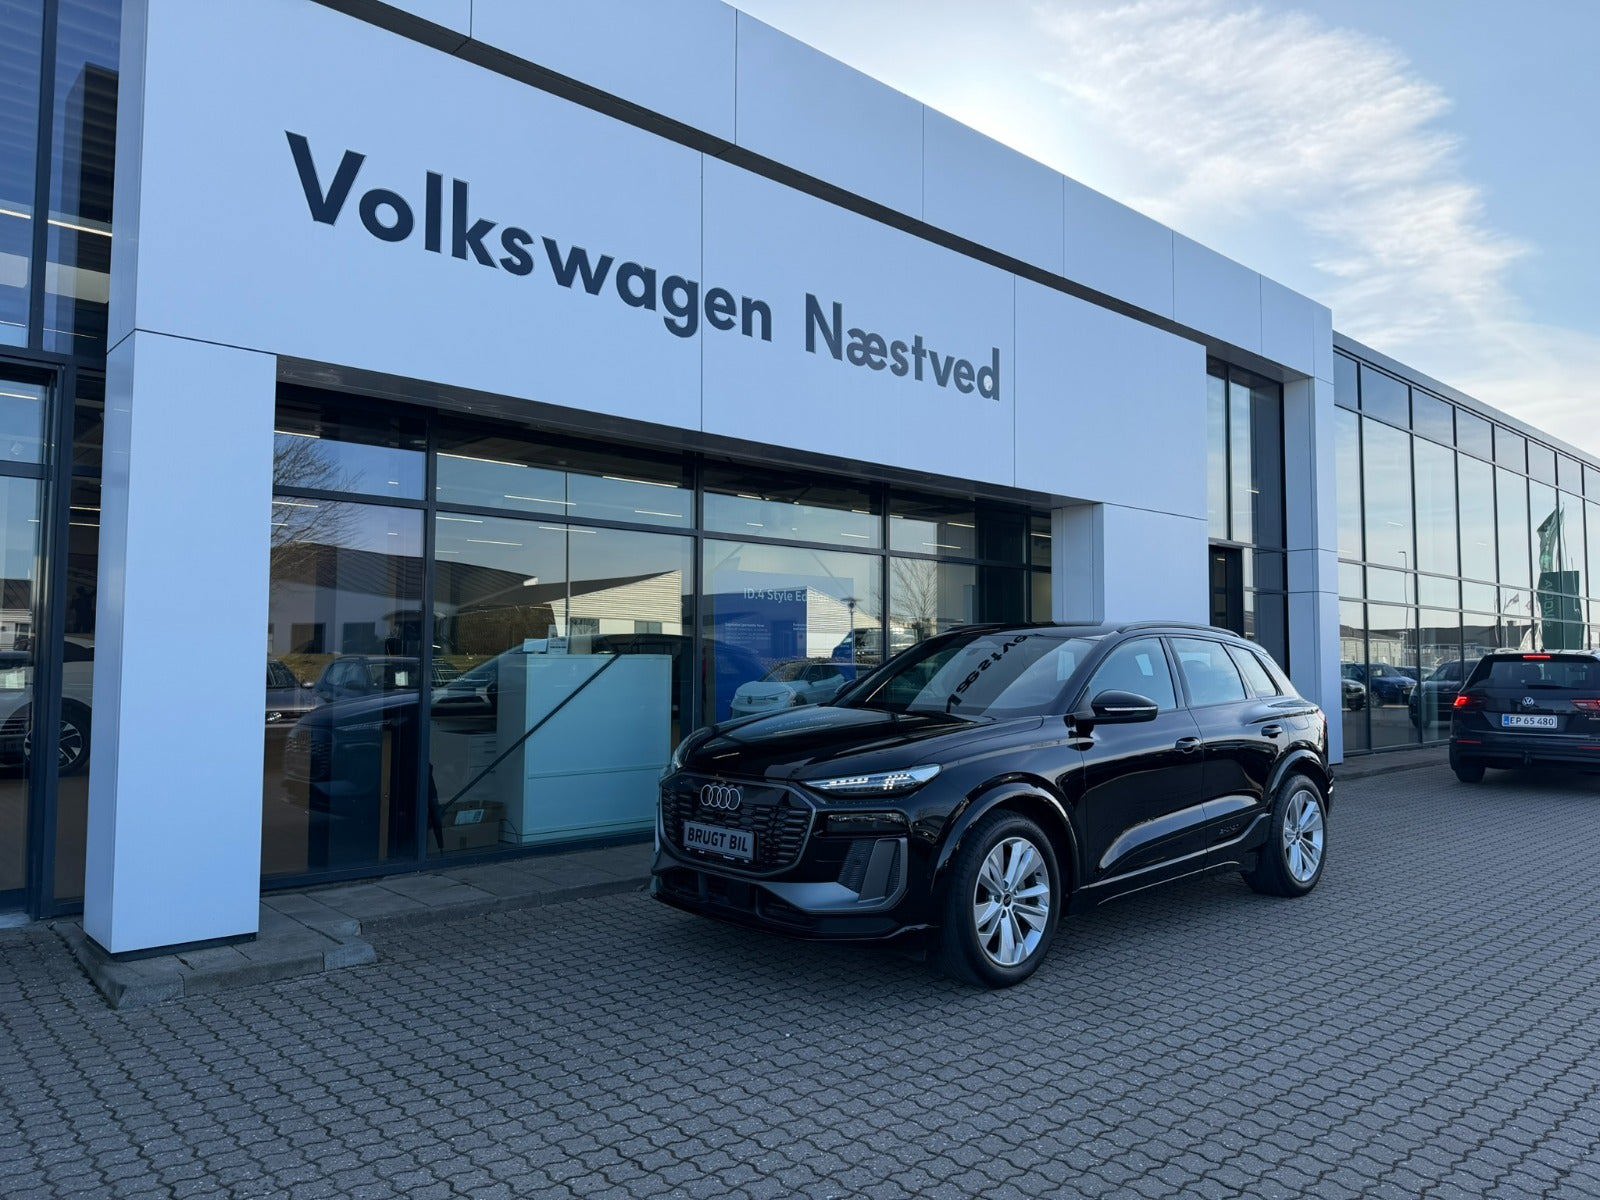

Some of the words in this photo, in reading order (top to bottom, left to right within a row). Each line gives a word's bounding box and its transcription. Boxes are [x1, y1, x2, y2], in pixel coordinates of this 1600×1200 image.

[284, 129, 773, 342] Volkswagen
[804, 291, 1000, 402] Næstved
[743, 588, 765, 600] ID.4
[767, 589, 793, 603] Style
[1510, 716, 1522, 725] EP
[1523, 717, 1535, 725] 65
[1537, 717, 1554, 726] 480
[687, 826, 727, 848] BRUGT
[729, 834, 748, 852] BIL
